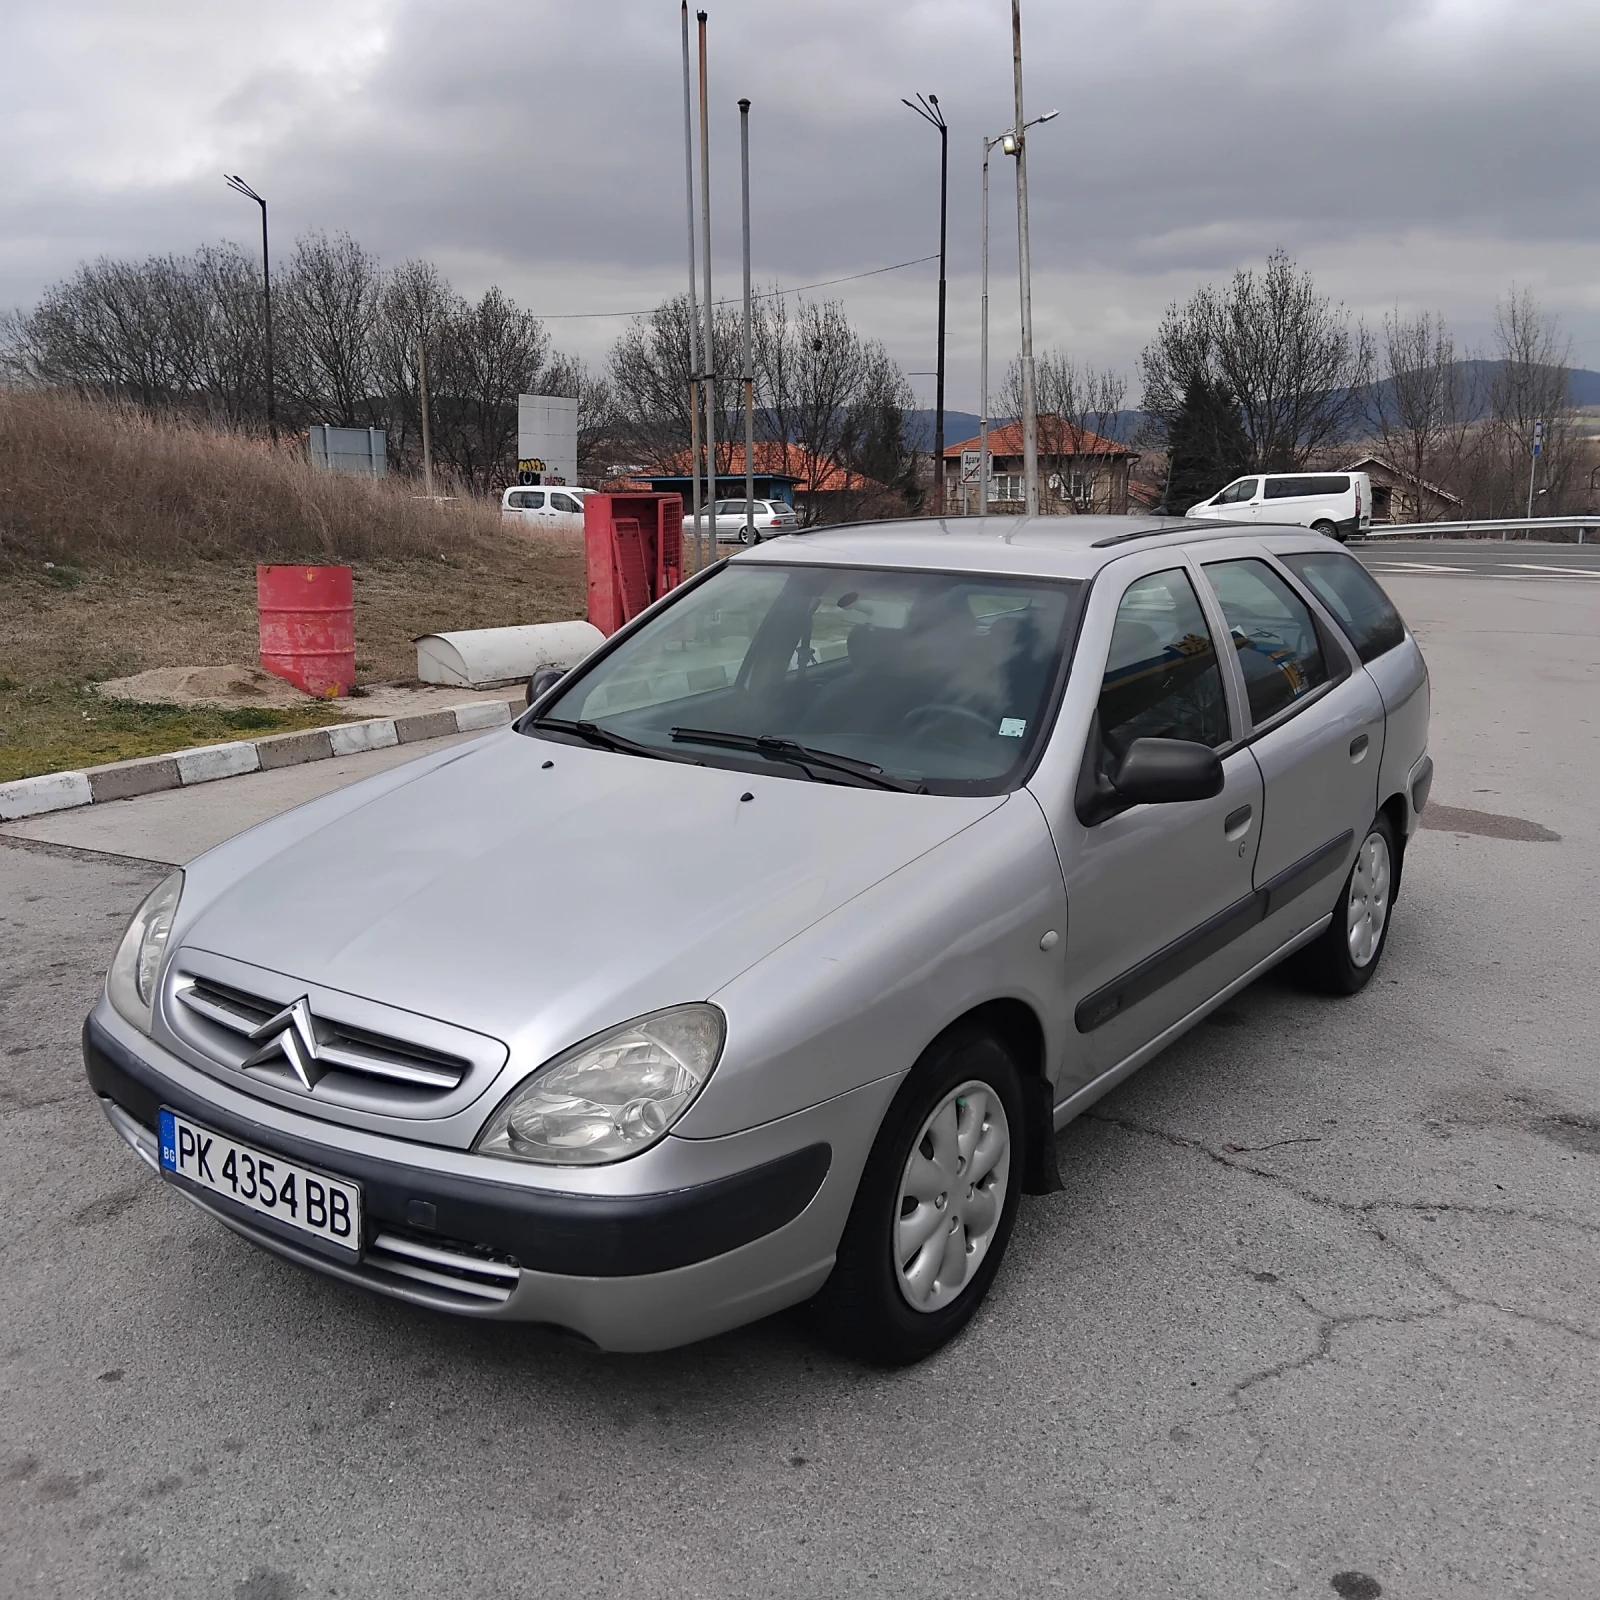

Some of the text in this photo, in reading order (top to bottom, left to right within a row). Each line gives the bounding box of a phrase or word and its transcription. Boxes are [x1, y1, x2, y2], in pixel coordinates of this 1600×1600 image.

[163, 1146, 176, 1163] BG
[178, 1125, 351, 1237] PK 4354 BB
